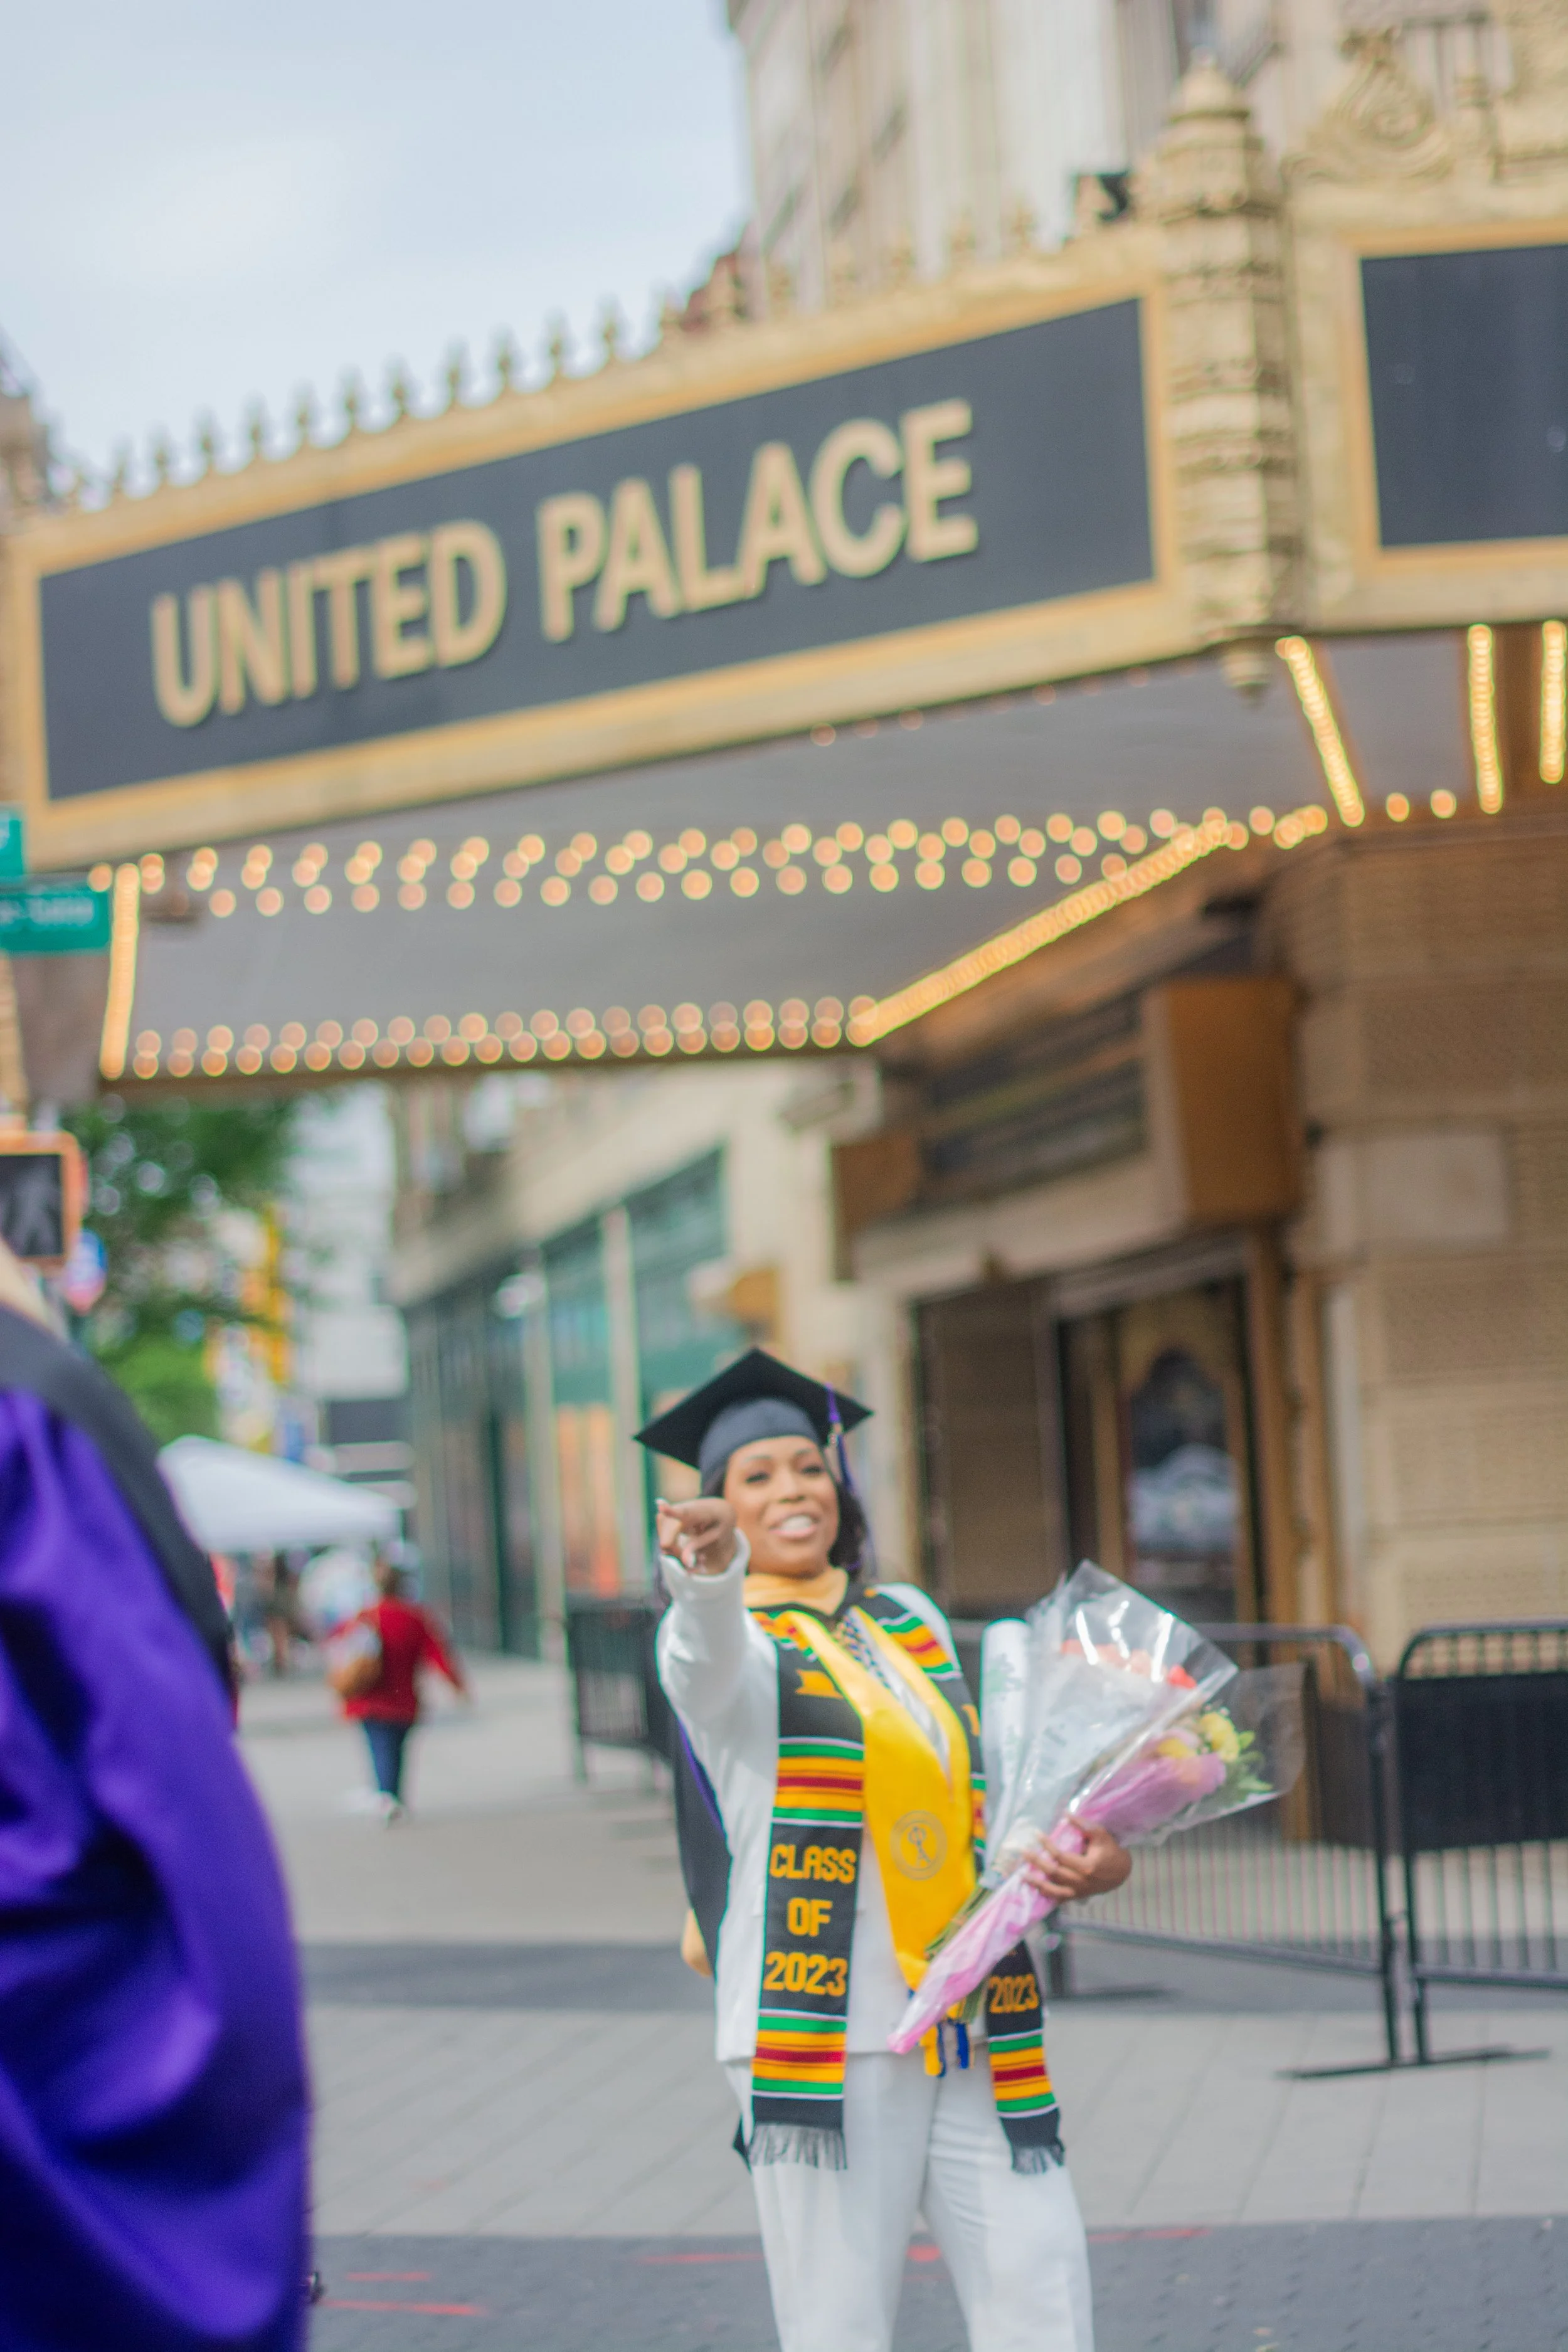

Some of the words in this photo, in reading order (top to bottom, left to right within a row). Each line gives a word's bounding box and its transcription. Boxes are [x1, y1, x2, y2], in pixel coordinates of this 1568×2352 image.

[151, 518, 507, 729] UNITED
[535, 396, 979, 644] PALACE
[769, 1843, 857, 1885] CLASS
[787, 1897, 833, 1937] OF
[762, 1950, 849, 1998] 2023
[988, 1973, 1039, 2013] 2023
